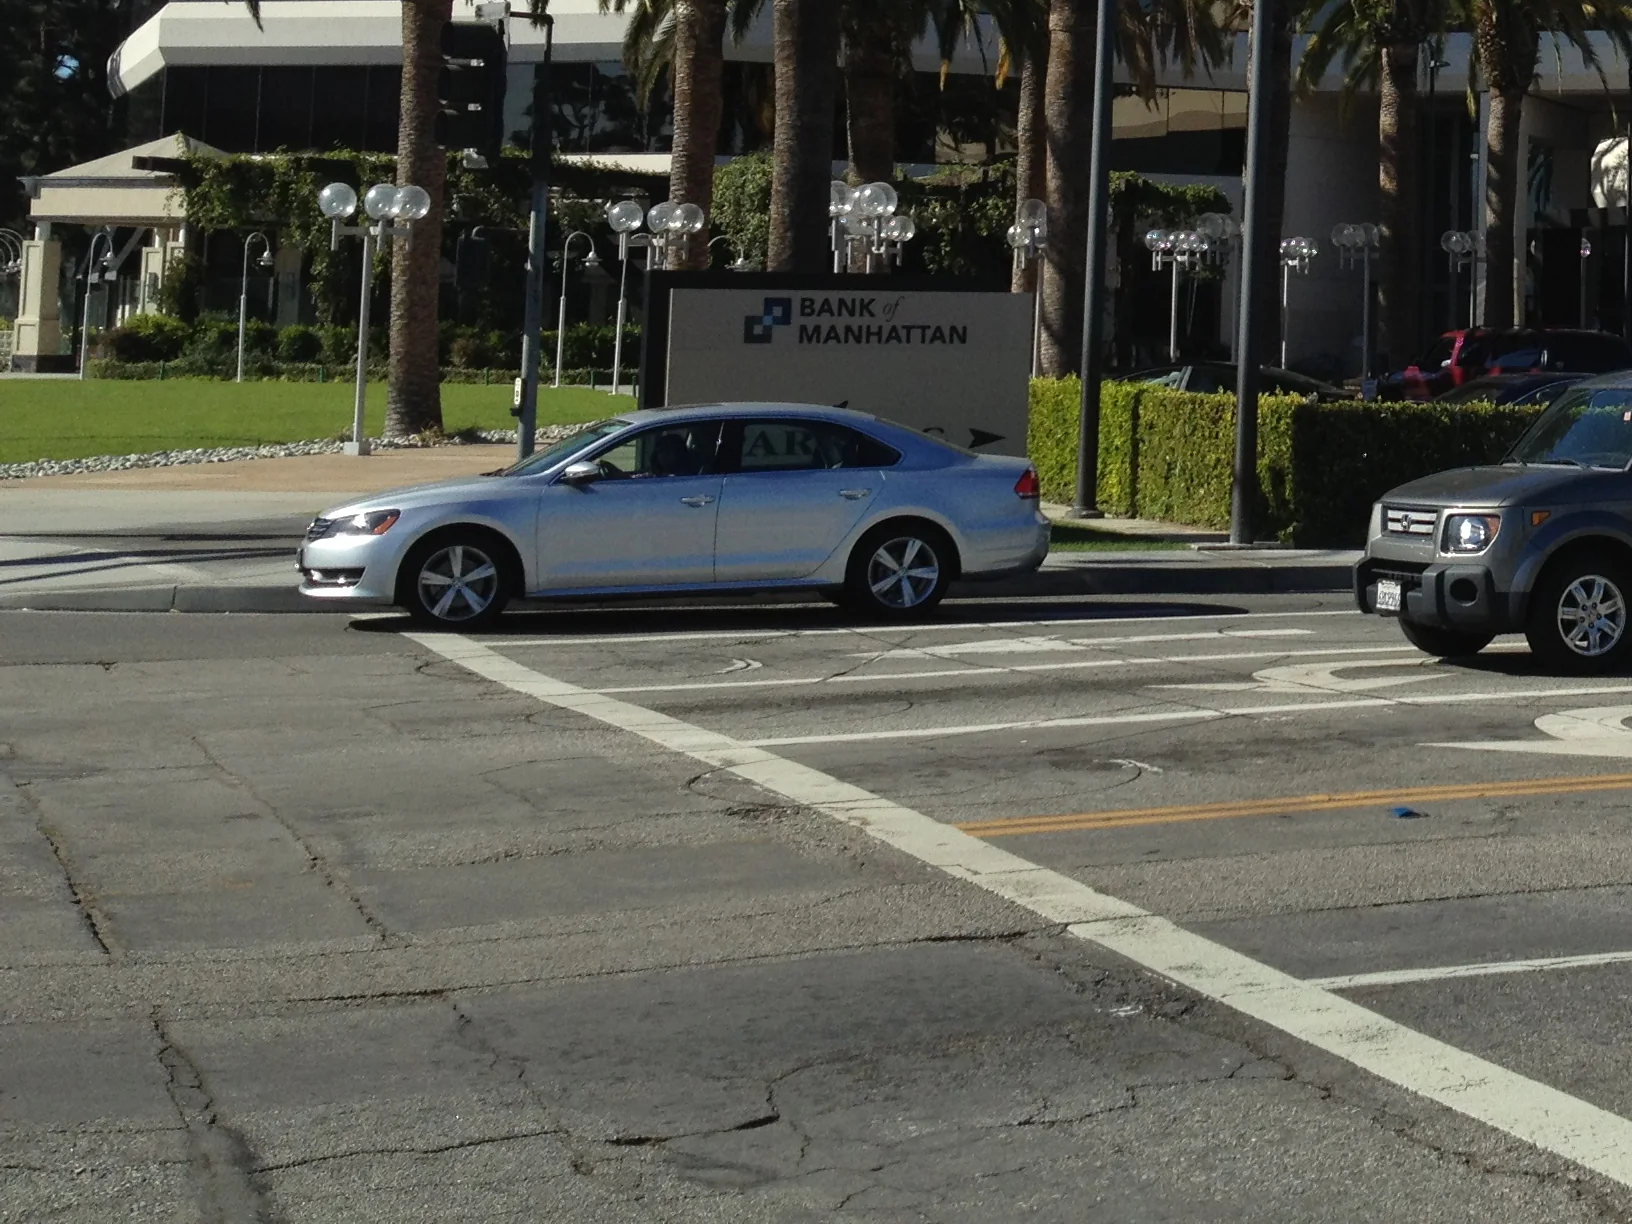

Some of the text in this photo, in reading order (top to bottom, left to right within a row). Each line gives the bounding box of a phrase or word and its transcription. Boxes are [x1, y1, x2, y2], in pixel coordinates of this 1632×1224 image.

[800, 296, 905, 322] BANK of
[799, 325, 968, 344] MANHATTAN
